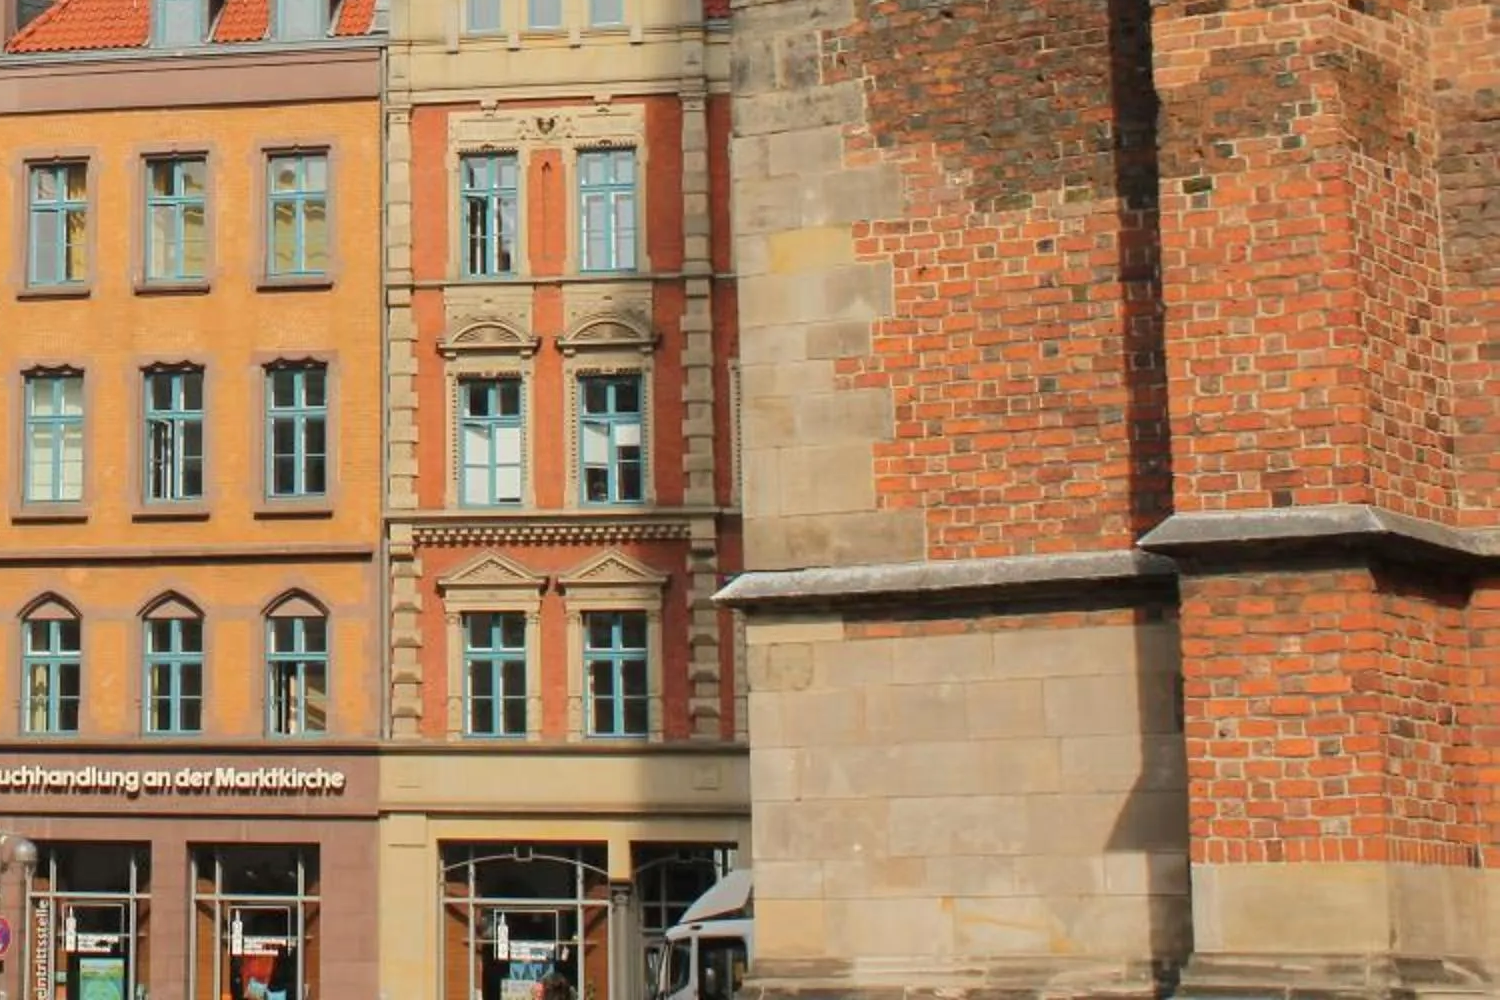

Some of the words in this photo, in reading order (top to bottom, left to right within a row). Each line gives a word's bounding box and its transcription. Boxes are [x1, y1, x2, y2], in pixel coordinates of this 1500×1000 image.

[143, 771, 171, 787] an
[175, 767, 211, 787] der
[214, 767, 345, 788] Marktkirche
